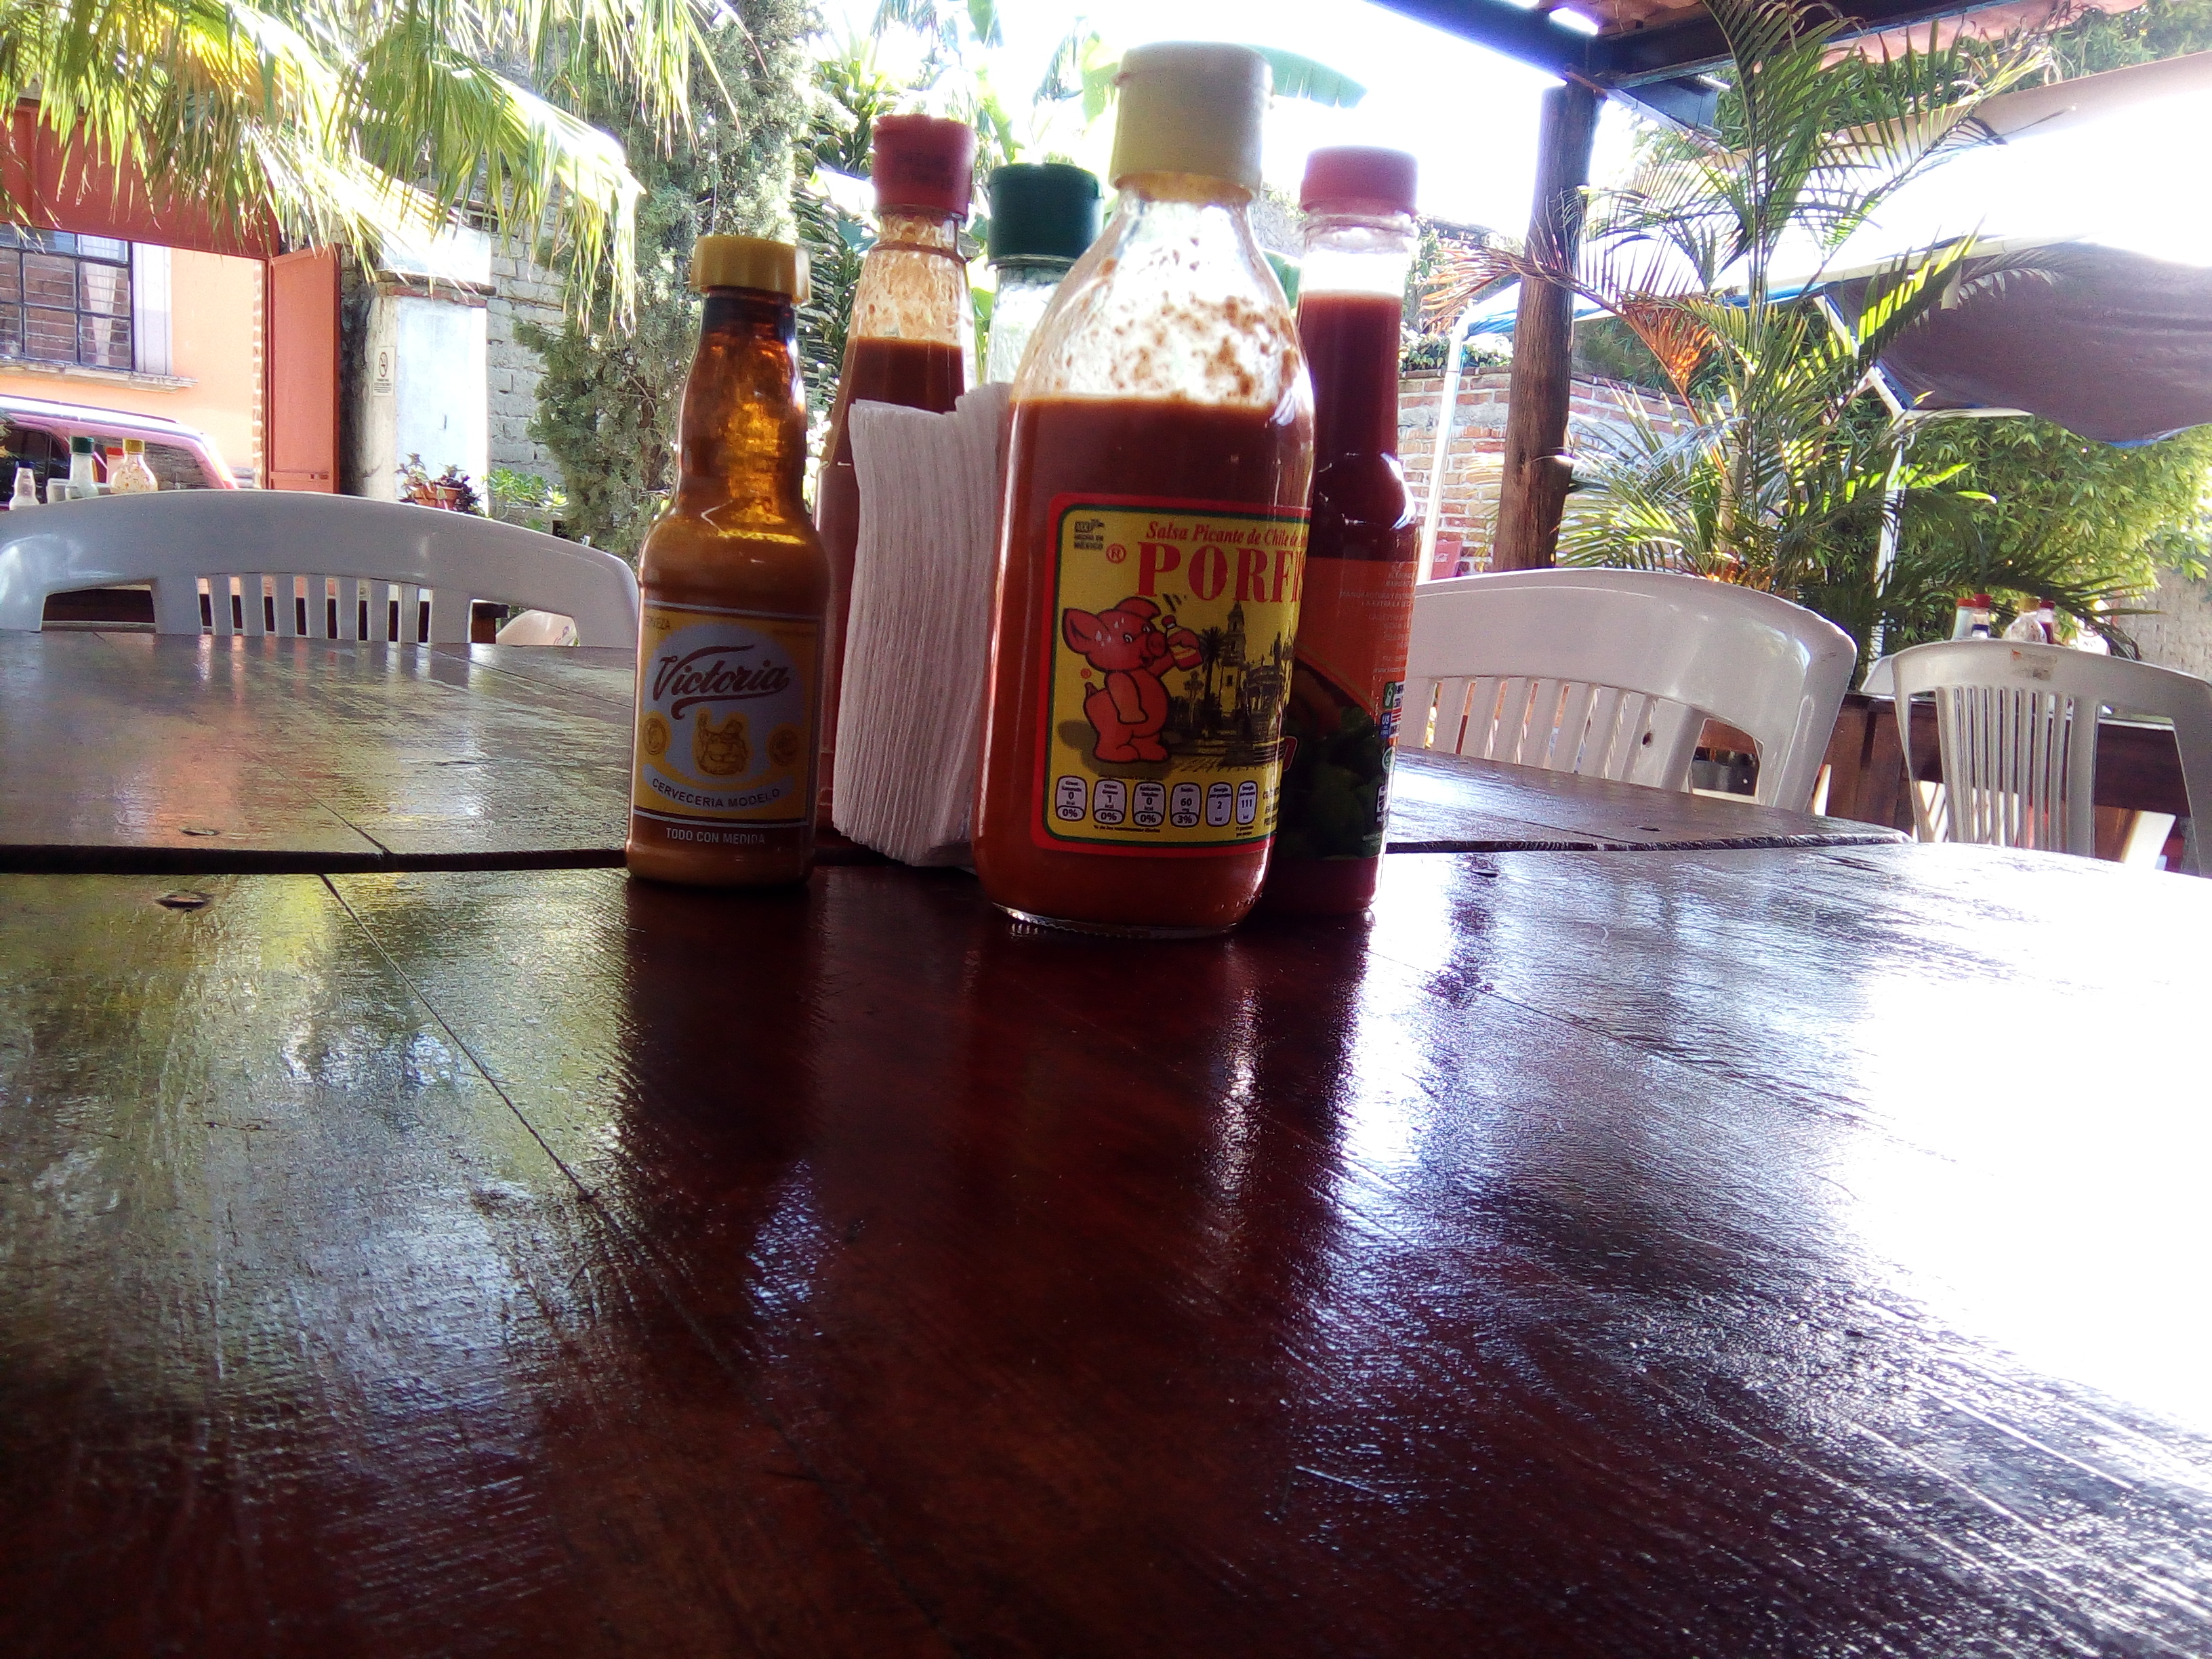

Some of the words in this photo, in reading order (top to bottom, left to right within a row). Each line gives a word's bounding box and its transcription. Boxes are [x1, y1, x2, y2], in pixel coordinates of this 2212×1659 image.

[1145, 520, 1188, 541] Salsa
[1192, 523, 1245, 544] Picante
[1246, 527, 1262, 545] de
[1265, 528, 1289, 547] Chile
[653, 644, 790, 717] Victoria
[652, 778, 724, 808] CERVECERIA
[728, 788, 779, 808] MODELO
[1068, 792, 1074, 800] 0
[1107, 795, 1112, 803] 1
[1146, 797, 1153, 805] 0
[1180, 798, 1192, 806] 60
[1242, 799, 1252, 808] 111
[1217, 801, 1223, 810] 2
[1062, 808, 1078, 818] 0%
[1101, 812, 1118, 821] 0%
[1140, 814, 1156, 823] 0%
[1177, 815, 1193, 824] 3%
[666, 827, 693, 841] TODO
[697, 832, 719, 843] CON
[722, 833, 766, 844] MEDIDA
